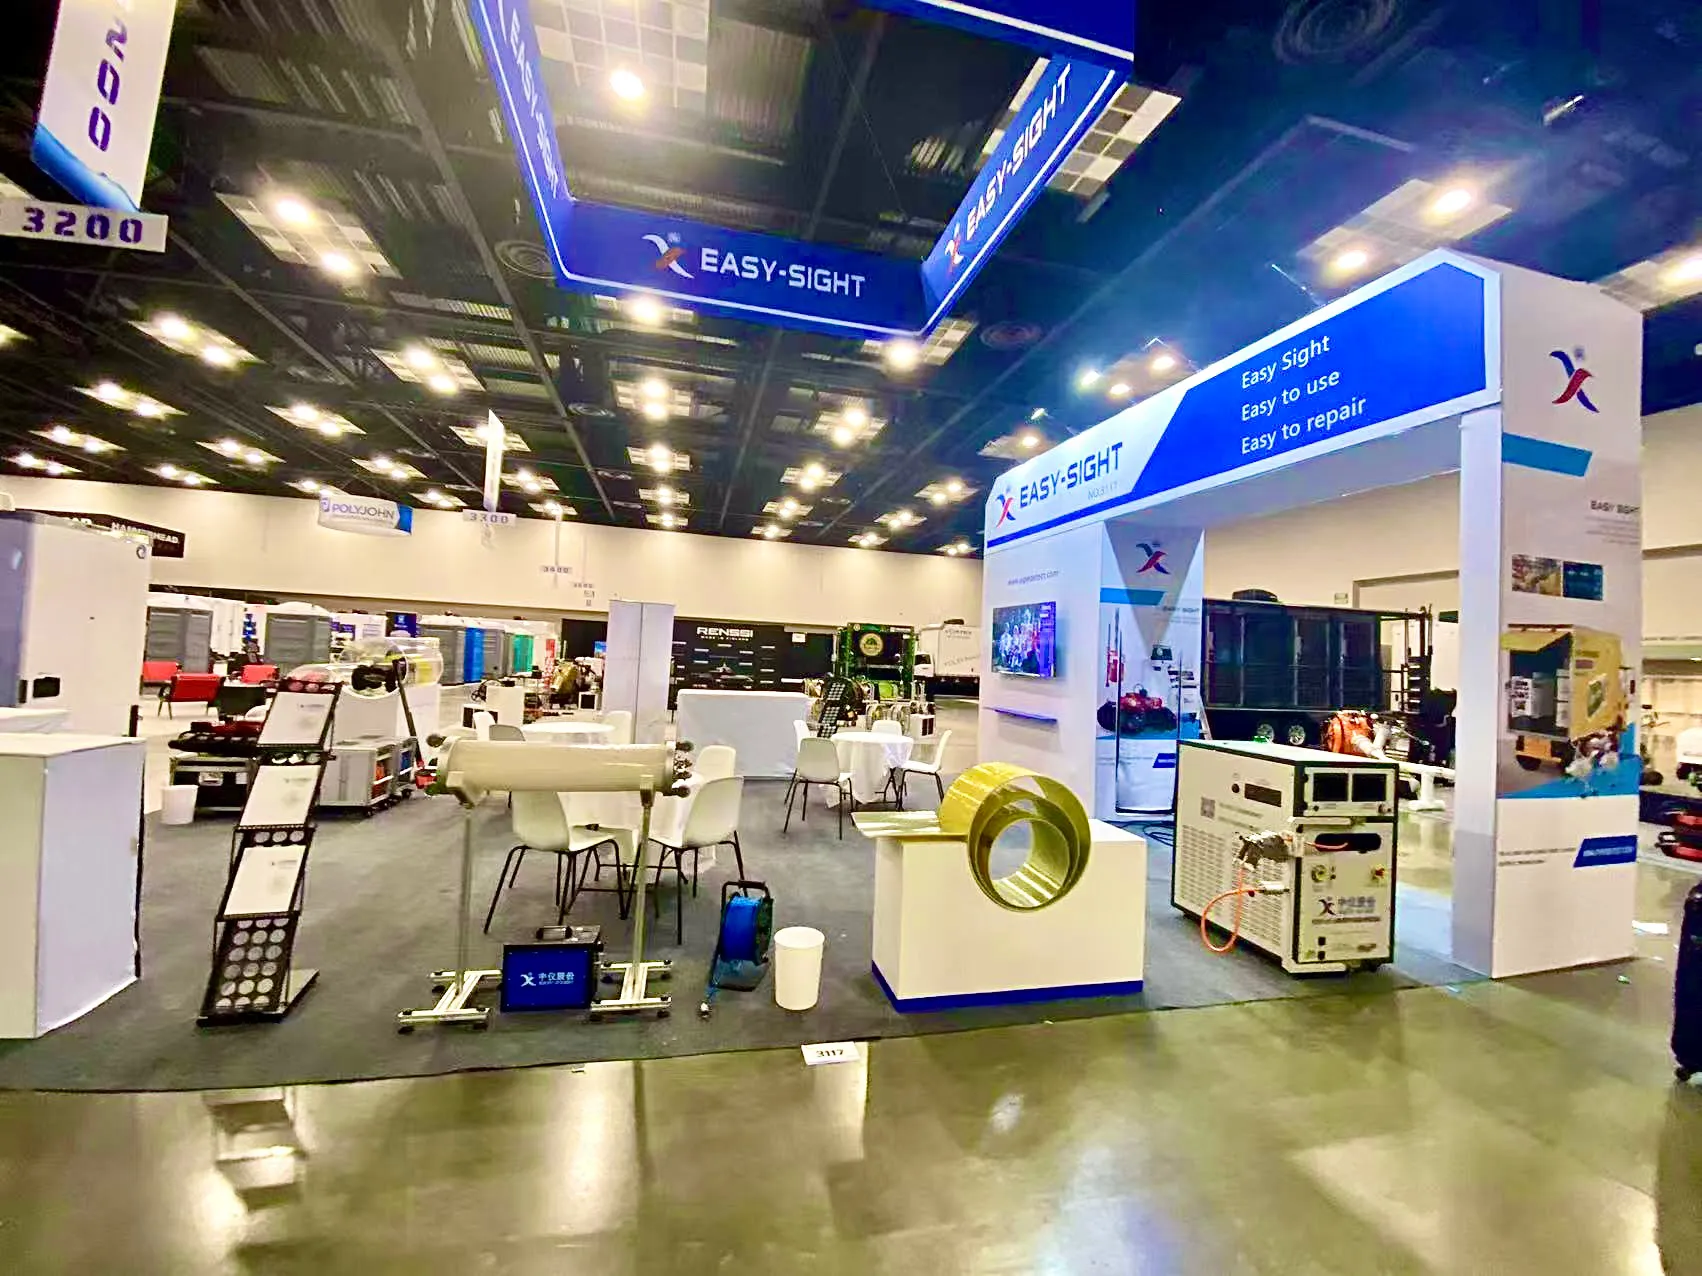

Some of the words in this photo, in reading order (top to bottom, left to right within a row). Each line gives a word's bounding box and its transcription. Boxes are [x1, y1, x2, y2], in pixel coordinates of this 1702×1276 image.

[88, 14, 128, 152] 200
[966, 63, 1071, 241] EASY-SIGHT
[22, 207, 143, 244] 3200
[701, 247, 866, 297] EASY-SIGHT
[1241, 361, 1277, 389] Easy
[1282, 335, 1330, 371] Sight
[1241, 397, 1277, 422] Easy
[1282, 388, 1301, 405] to
[1307, 371, 1340, 395] use
[1241, 431, 1277, 455] Easy
[1282, 423, 1301, 439] to
[1307, 397, 1367, 431] repair
[1020, 442, 1123, 508] EASY-SIGHT
[332, 503, 394, 520] POLYJOHN
[469, 512, 509, 524] 3300
[697, 626, 753, 638] RENSSI
[816, 1048, 843, 1057] 3117
